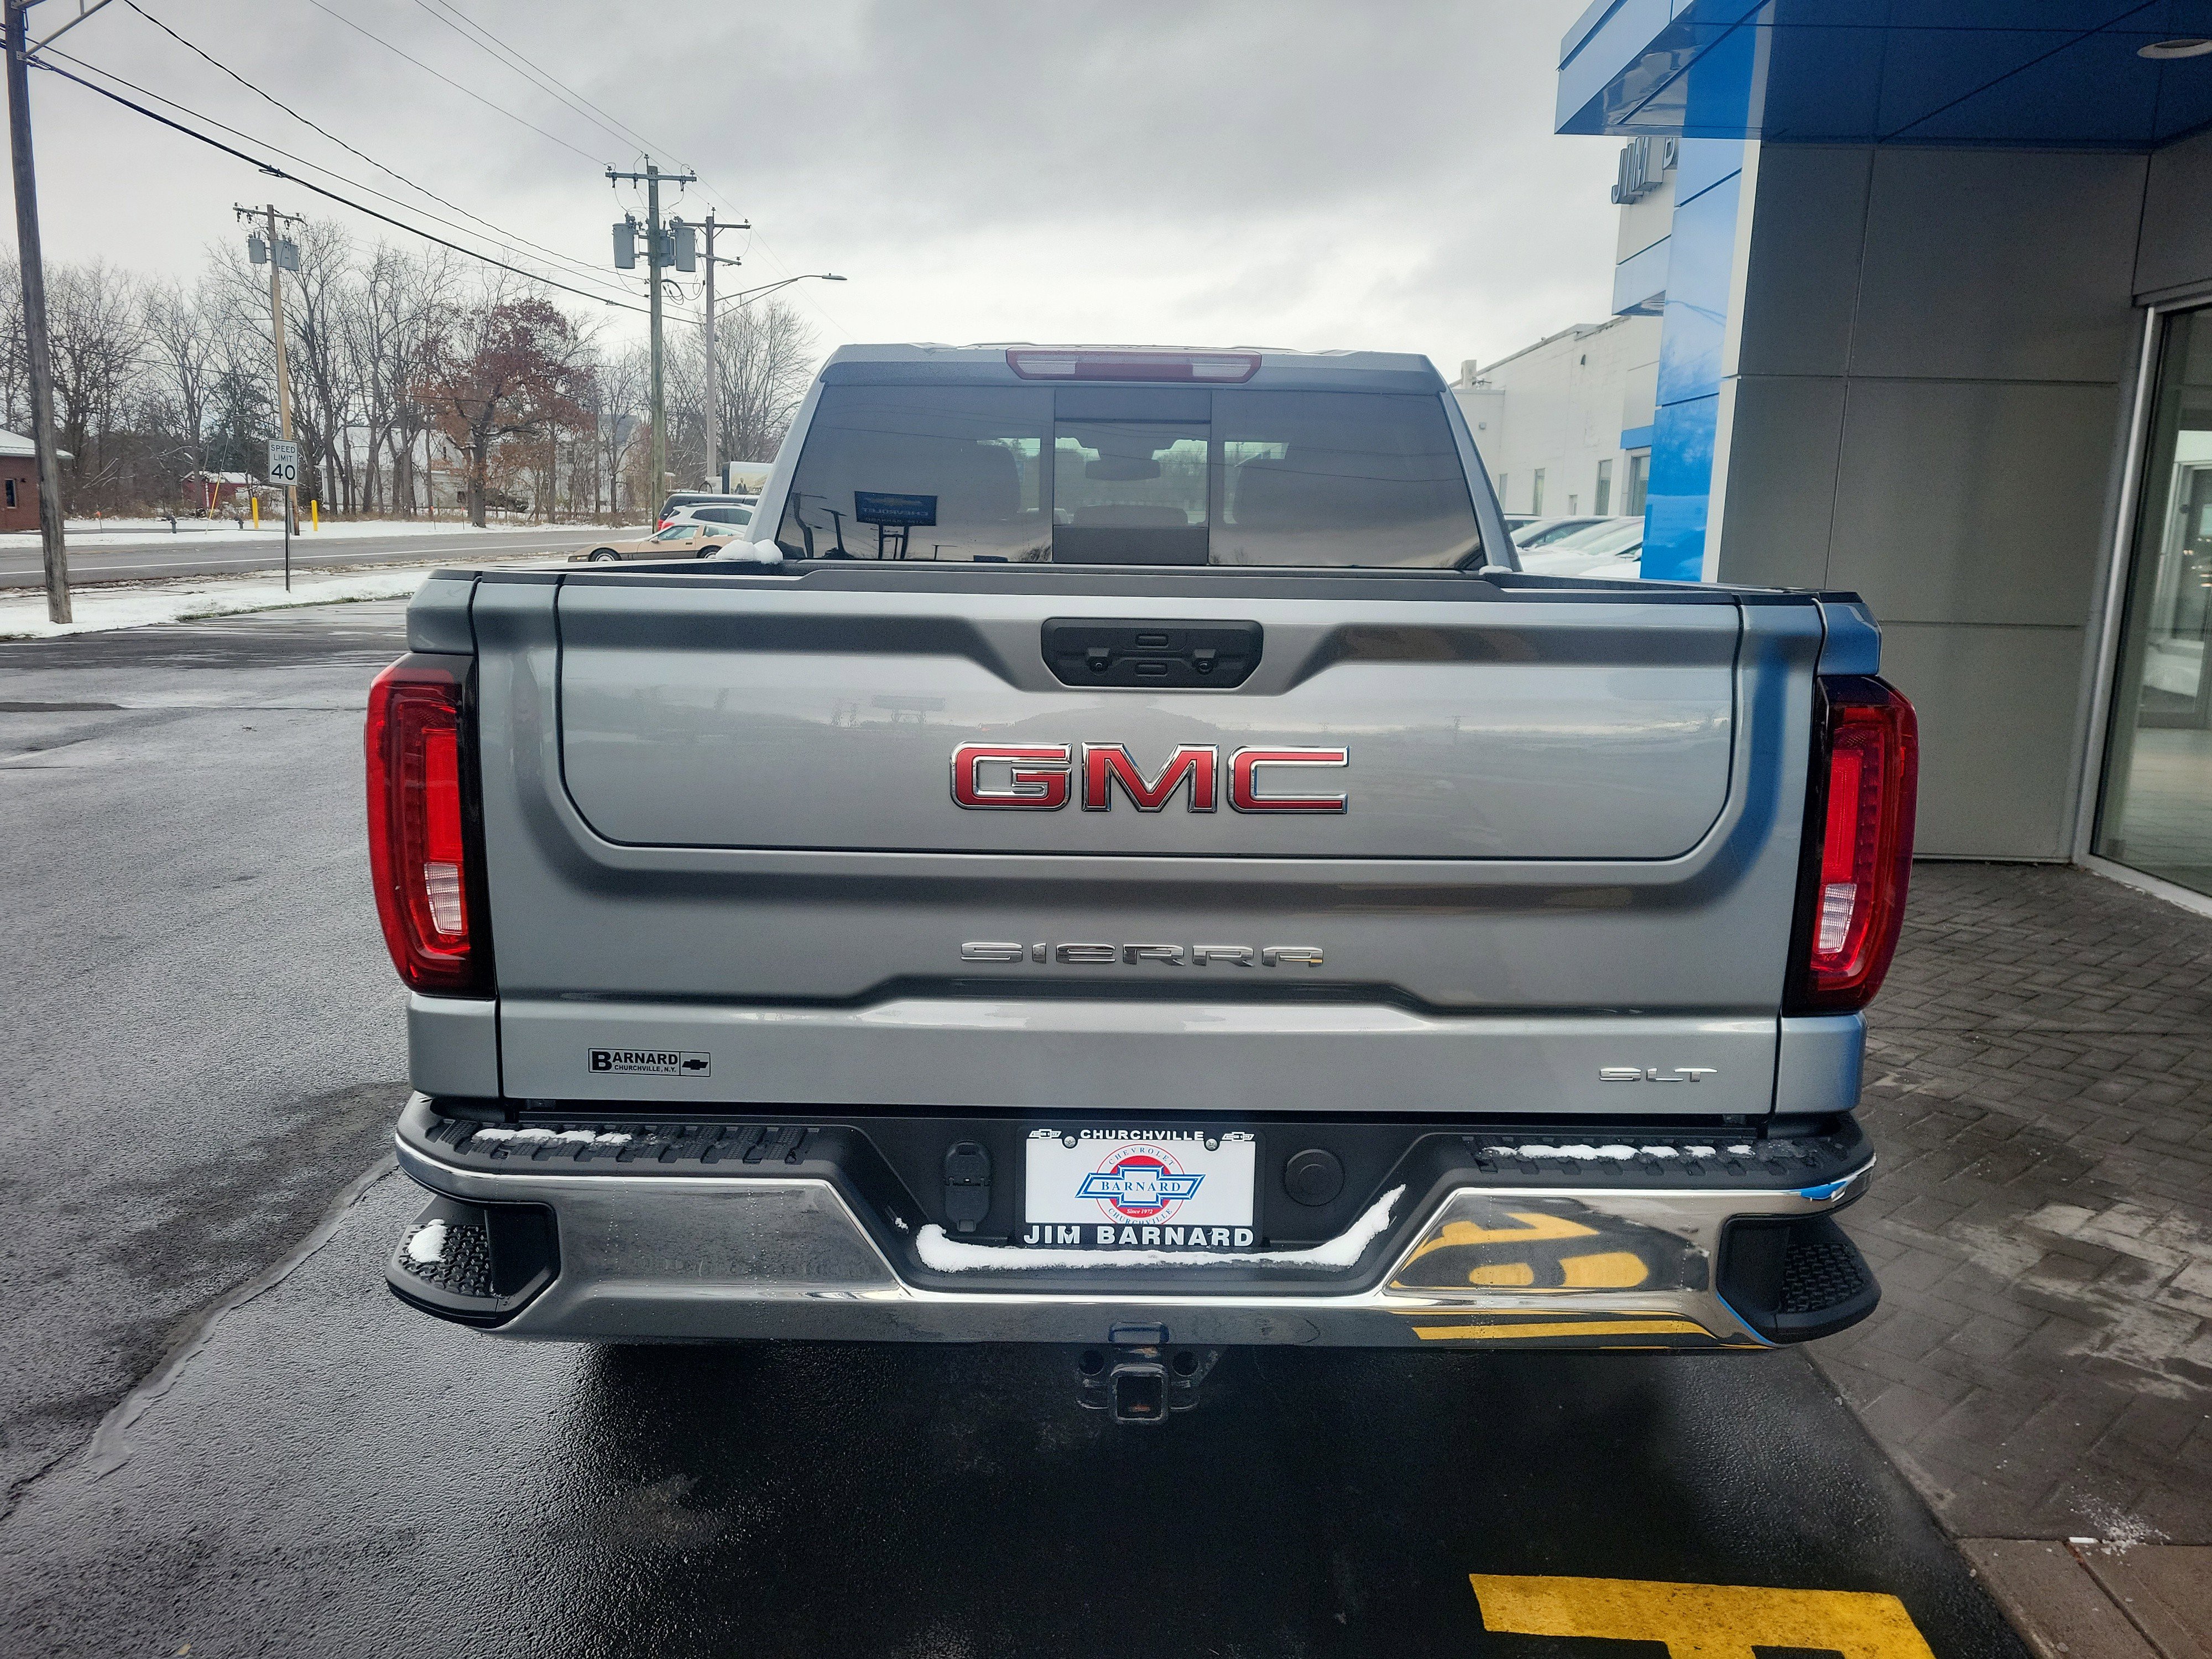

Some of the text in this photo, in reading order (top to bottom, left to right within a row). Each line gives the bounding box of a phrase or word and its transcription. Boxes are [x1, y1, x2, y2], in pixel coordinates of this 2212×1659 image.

[1611, 137, 1649, 204] JIM
[271, 445, 295, 453] SPEED
[272, 464, 295, 480] 40
[950, 741, 1350, 814] GMC
[961, 941, 1324, 967] SIERRA
[592, 1051, 678, 1071] BARNARD
[1599, 1067, 1718, 1082] SLT
[1080, 1129, 1204, 1141] CHURCHVILLE
[1108, 1147, 1175, 1166] CHEVROLET
[1101, 1181, 1181, 1192] BARNARD
[1108, 1208, 1173, 1224] CHURCHVILLE
[1024, 1225, 1254, 1247] JIM BARNARD
